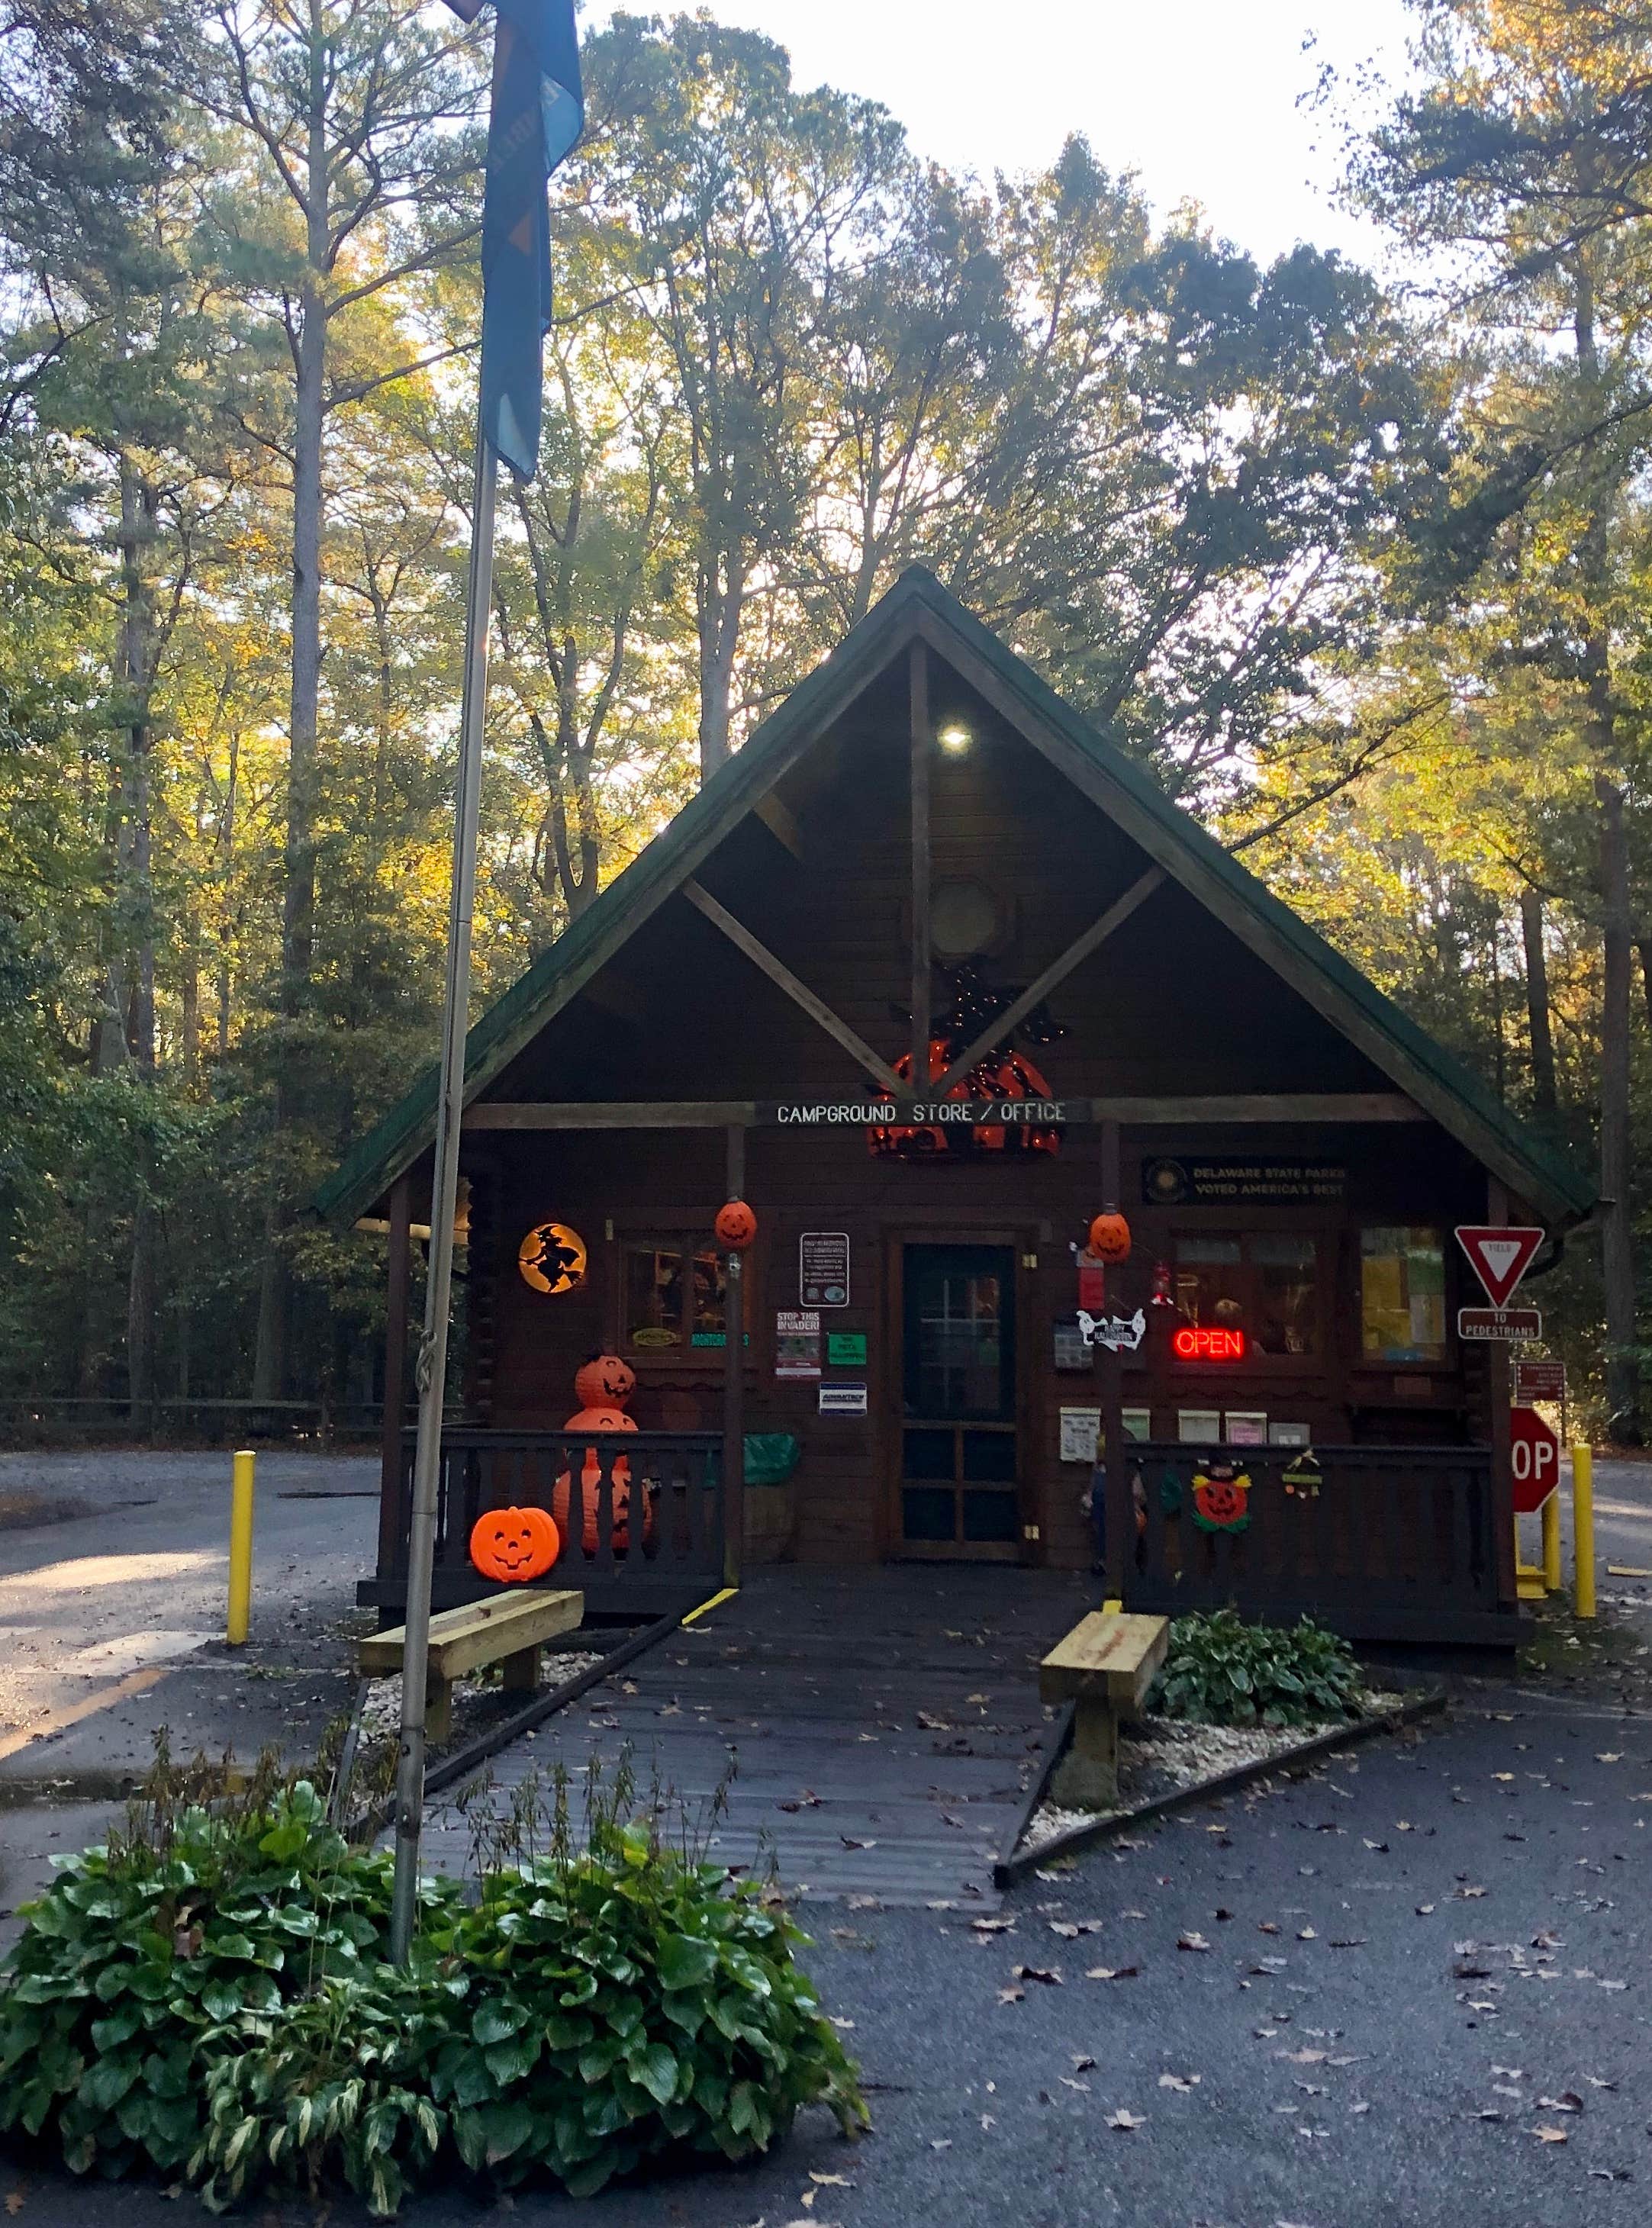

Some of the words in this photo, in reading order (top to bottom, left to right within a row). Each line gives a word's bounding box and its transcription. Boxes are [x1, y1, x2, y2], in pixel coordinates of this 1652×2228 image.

[778, 1106, 897, 1124] CAMPGROUND
[913, 1103, 973, 1122] STORE
[1000, 1102, 1067, 1122] OFFICE
[1193, 1167, 1261, 1179] DELAWARE
[1265, 1167, 1301, 1179] STATE
[1194, 1183, 1238, 1196] VOTED
[1241, 1183, 1309, 1195] AMERICA'S
[1313, 1183, 1344, 1195] BEST
[1488, 1243, 1512, 1253] YIELD
[777, 1312, 799, 1322] STOP
[800, 1312, 820, 1322] THIS
[1493, 1312, 1506, 1324] TO
[777, 1321, 820, 1331] INVADER!
[1465, 1325, 1535, 1338] PEDESTRIANS
[1176, 1331, 1241, 1354] OPEN
[1511, 1439, 1554, 1480] OP
